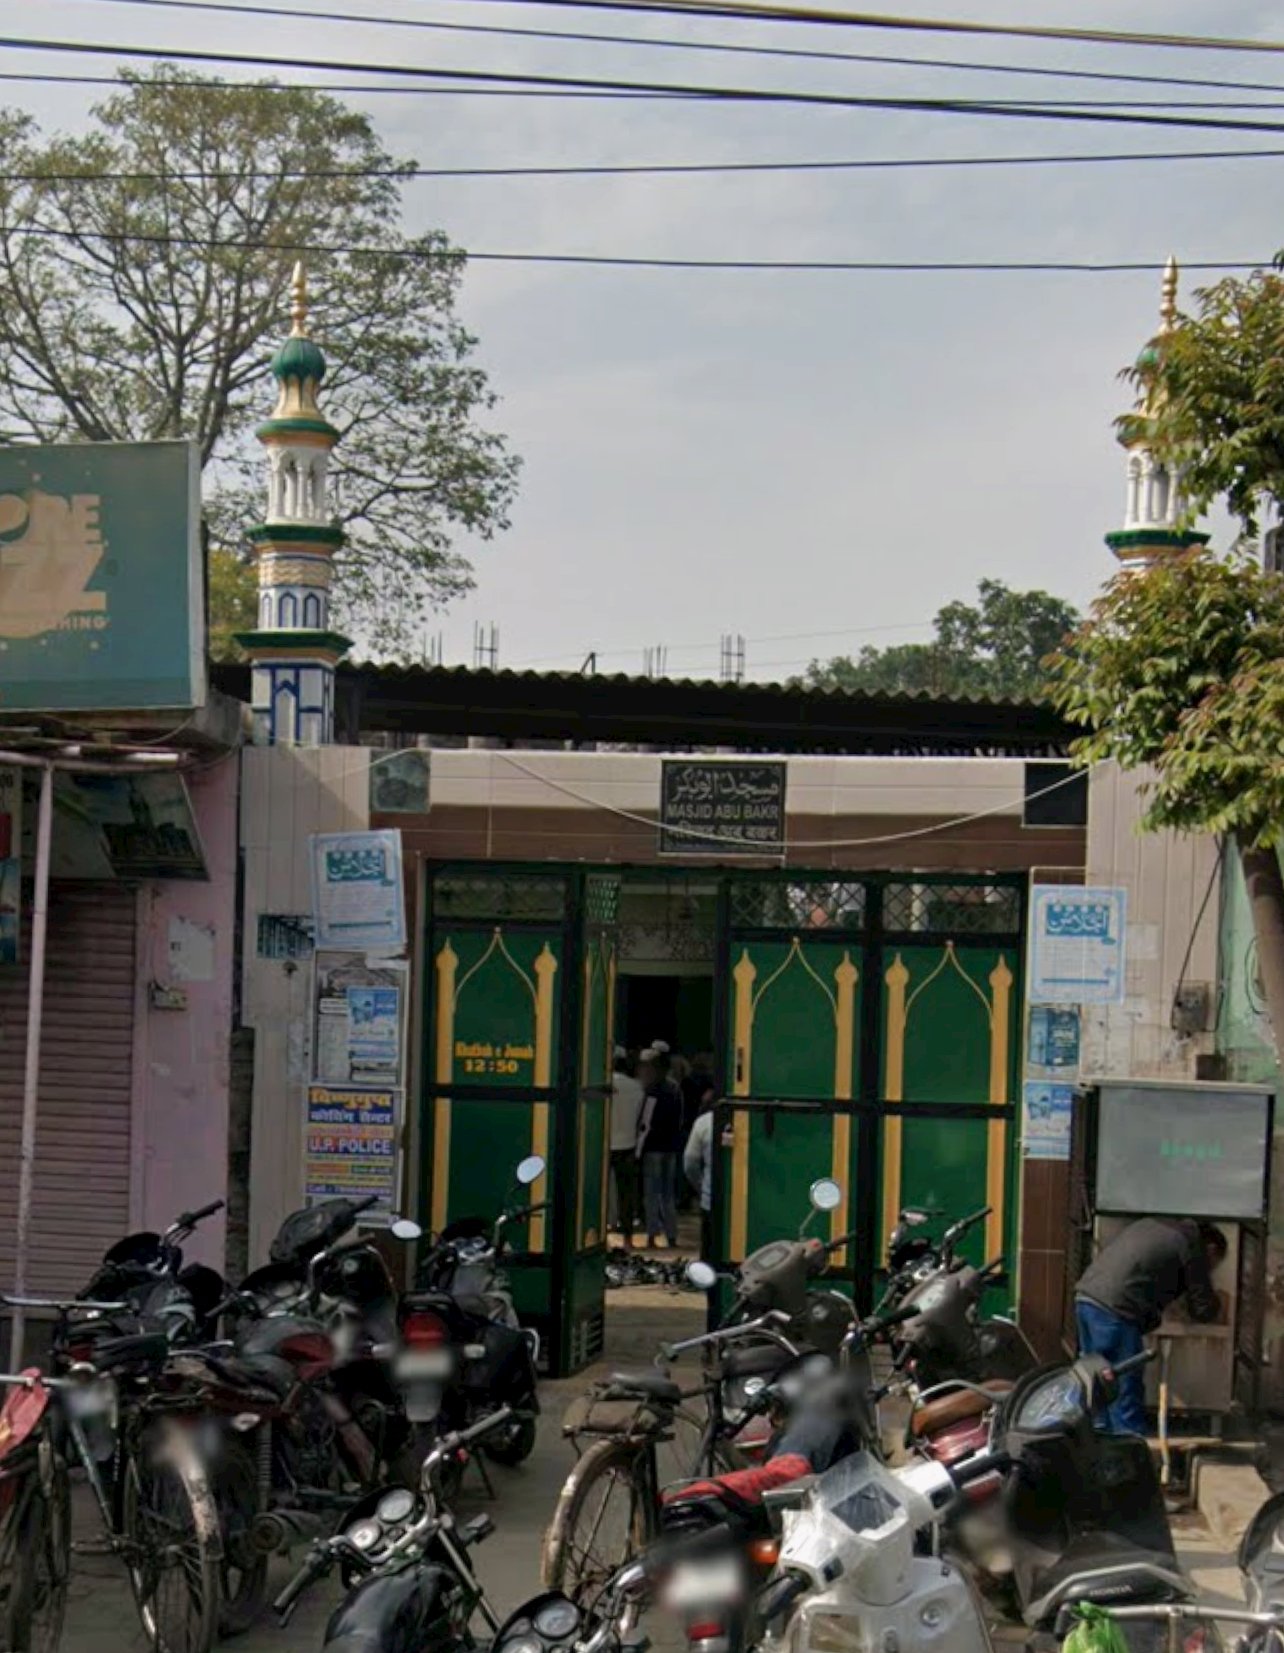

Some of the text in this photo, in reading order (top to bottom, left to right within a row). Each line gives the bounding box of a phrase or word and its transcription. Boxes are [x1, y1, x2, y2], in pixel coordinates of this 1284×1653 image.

[667, 804, 779, 819] MASJID ABU BAKR
[338, 1138, 392, 1155] POLICE
[1089, 1584, 1134, 1598] HONDA
